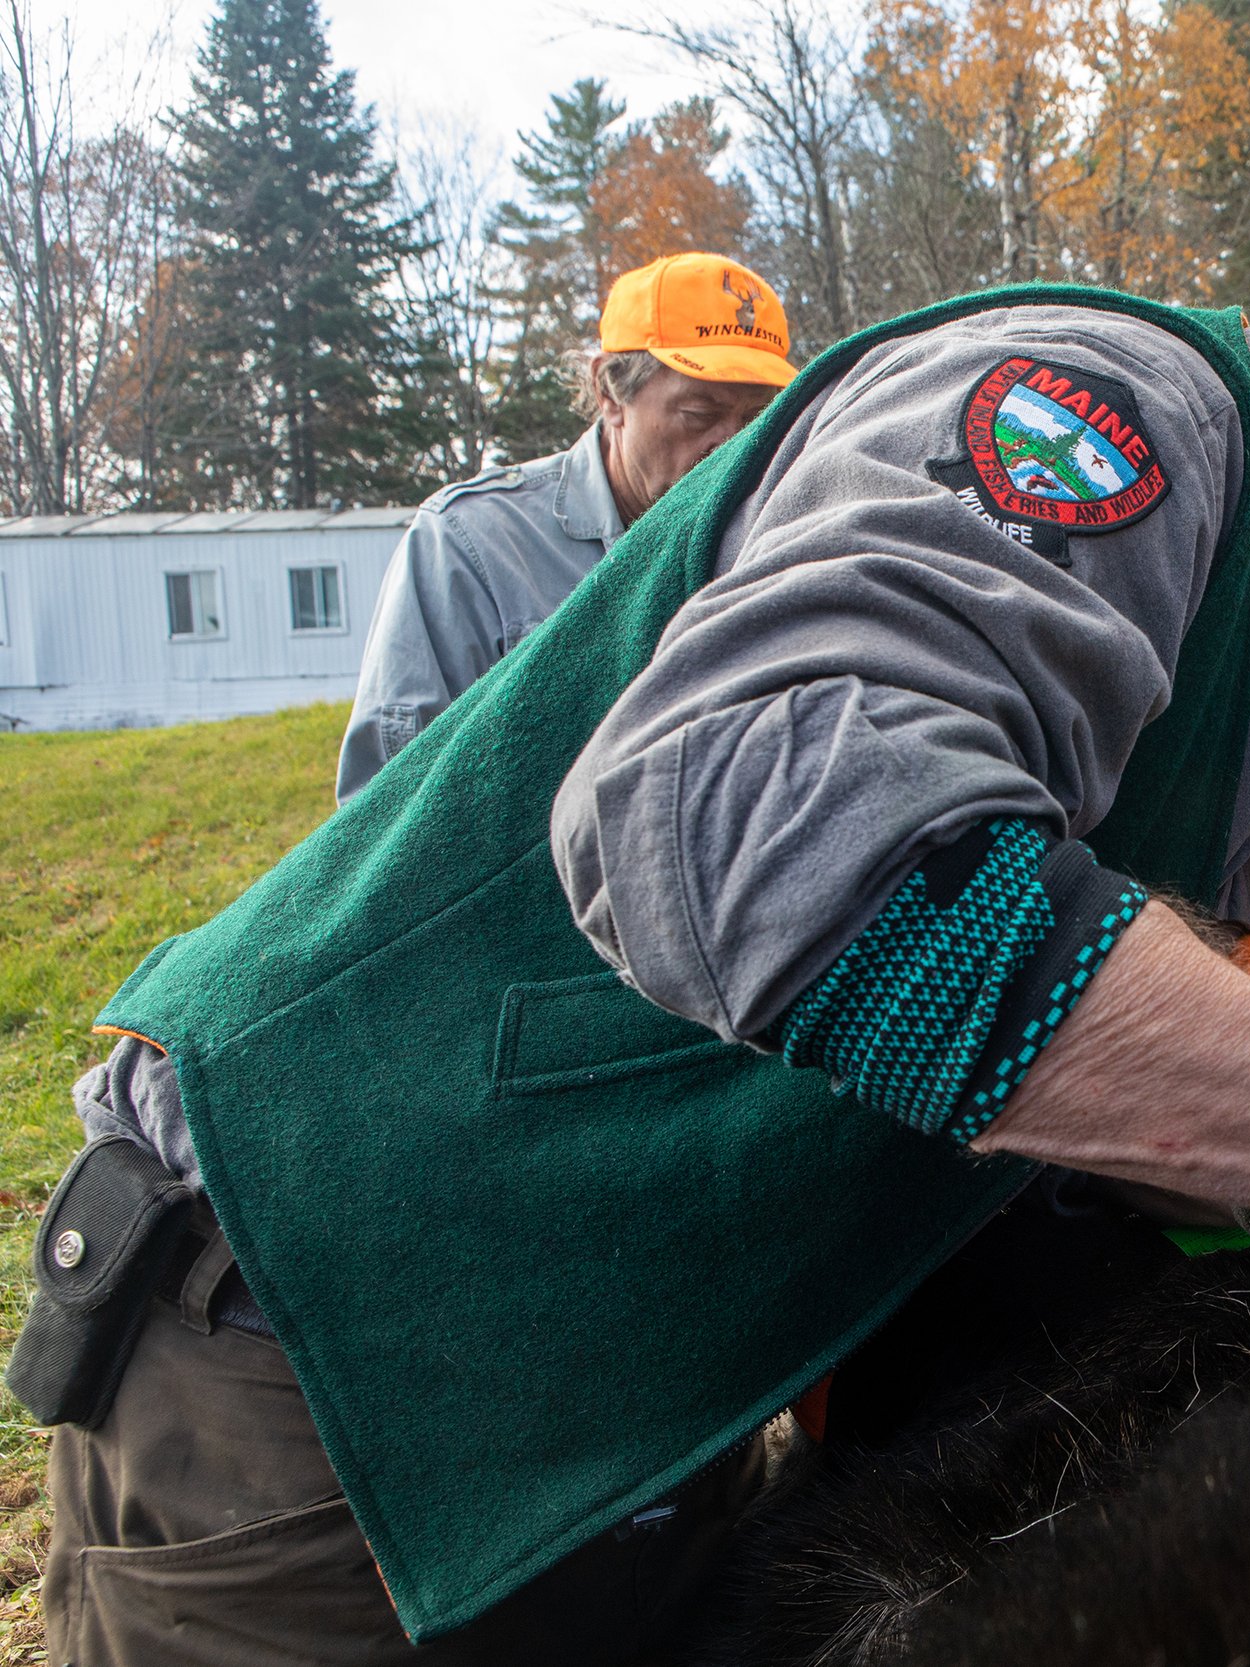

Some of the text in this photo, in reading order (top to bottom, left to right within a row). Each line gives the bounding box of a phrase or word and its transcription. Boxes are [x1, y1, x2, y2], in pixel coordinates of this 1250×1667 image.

[695, 324, 785, 351] WINCHESTER
[969, 403, 993, 453] INLAND
[1075, 503, 1109, 524] AND
[1109, 469, 1162, 518] WILDLIFE
[1026, 368, 1149, 468] MAINE
